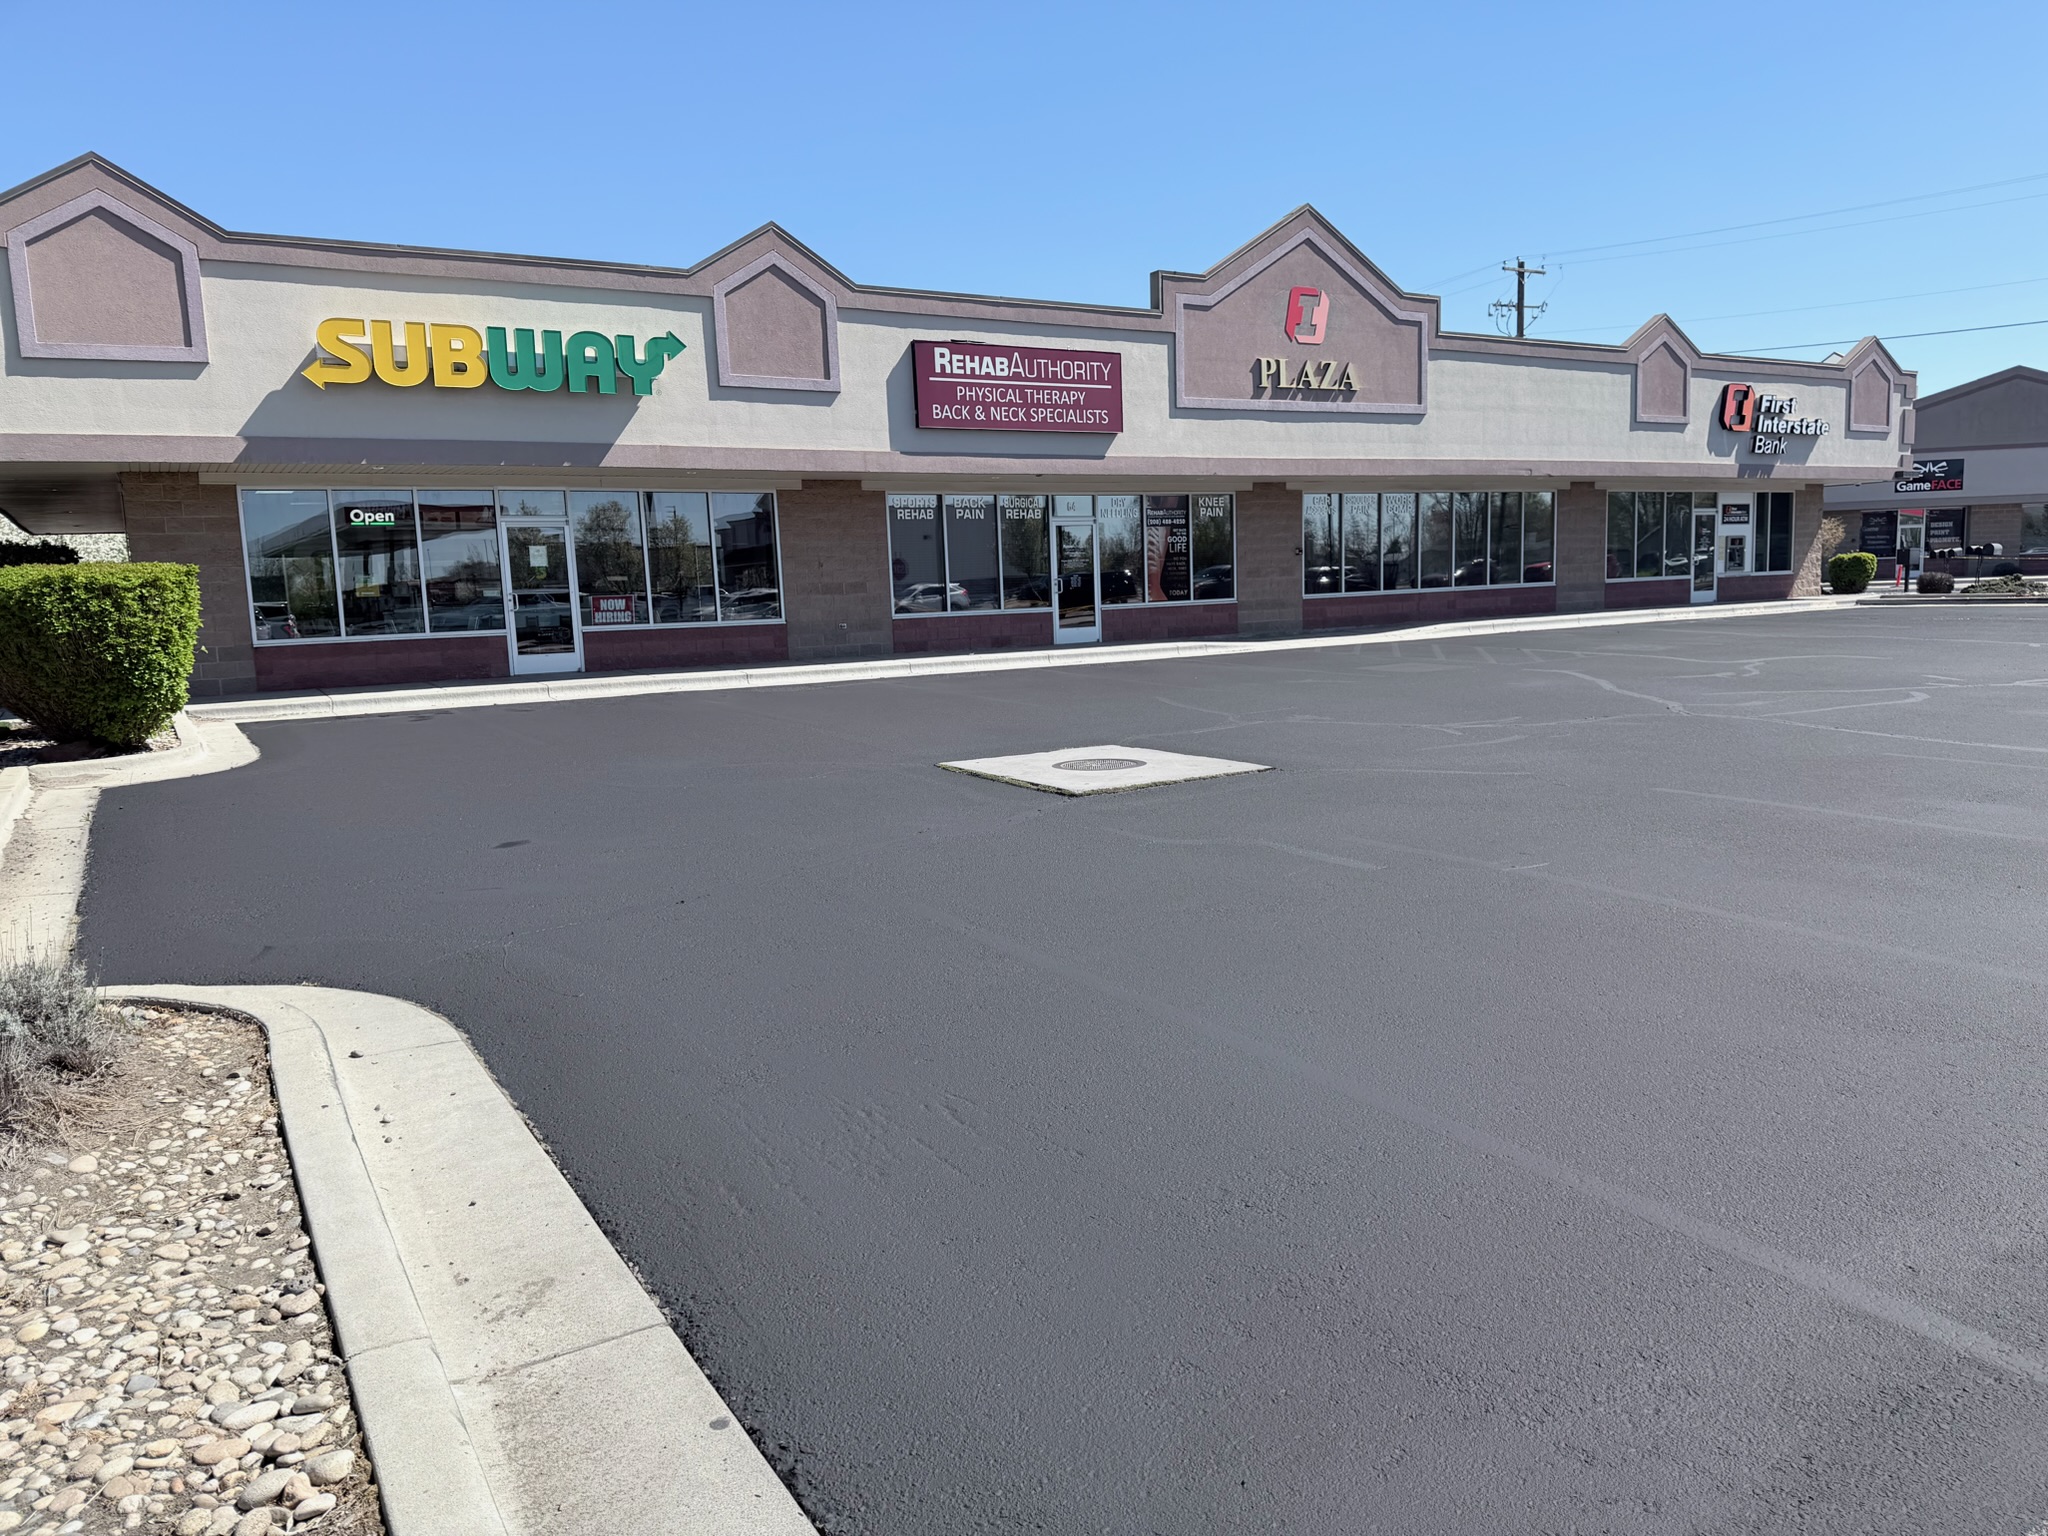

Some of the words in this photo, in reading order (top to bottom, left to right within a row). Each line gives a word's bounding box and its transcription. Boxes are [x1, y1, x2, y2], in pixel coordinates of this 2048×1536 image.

[301, 317, 687, 396] SUBWAY
[1257, 357, 1360, 391] PLAZA
[956, 386, 1023, 404] PHYSICAL
[1024, 389, 1086, 406] THERAPY
[1760, 394, 1798, 414] First
[932, 404, 970, 421] BACK
[974, 405, 986, 421] &
[990, 407, 1027, 422] NECK
[1030, 408, 1109, 424] SPECIALISTS
[1756, 415, 1830, 435] Interstate
[1753, 435, 1788, 455] Bank
[1896, 479, 1962, 492] GameFACE
[893, 497, 937, 509] SPORTS
[953, 497, 987, 509] BACK
[1003, 497, 1043, 509] SURGICAL
[1111, 498, 1126, 507] DRY
[1198, 497, 1225, 507] KNEE
[1312, 496, 1331, 506] CAR
[1385, 495, 1412, 505] WORK
[897, 509, 935, 520] REHAB
[956, 509, 985, 520] PAIN
[1006, 509, 1042, 520] REHAB
[1200, 507, 1224, 518] PAIN
[1350, 505, 1370, 514] PAIN
[349, 508, 395, 526] Open
[1169, 543, 1187, 553] LIFE
[599, 599, 626, 611] NOW
[594, 611, 632, 623] HIRING
